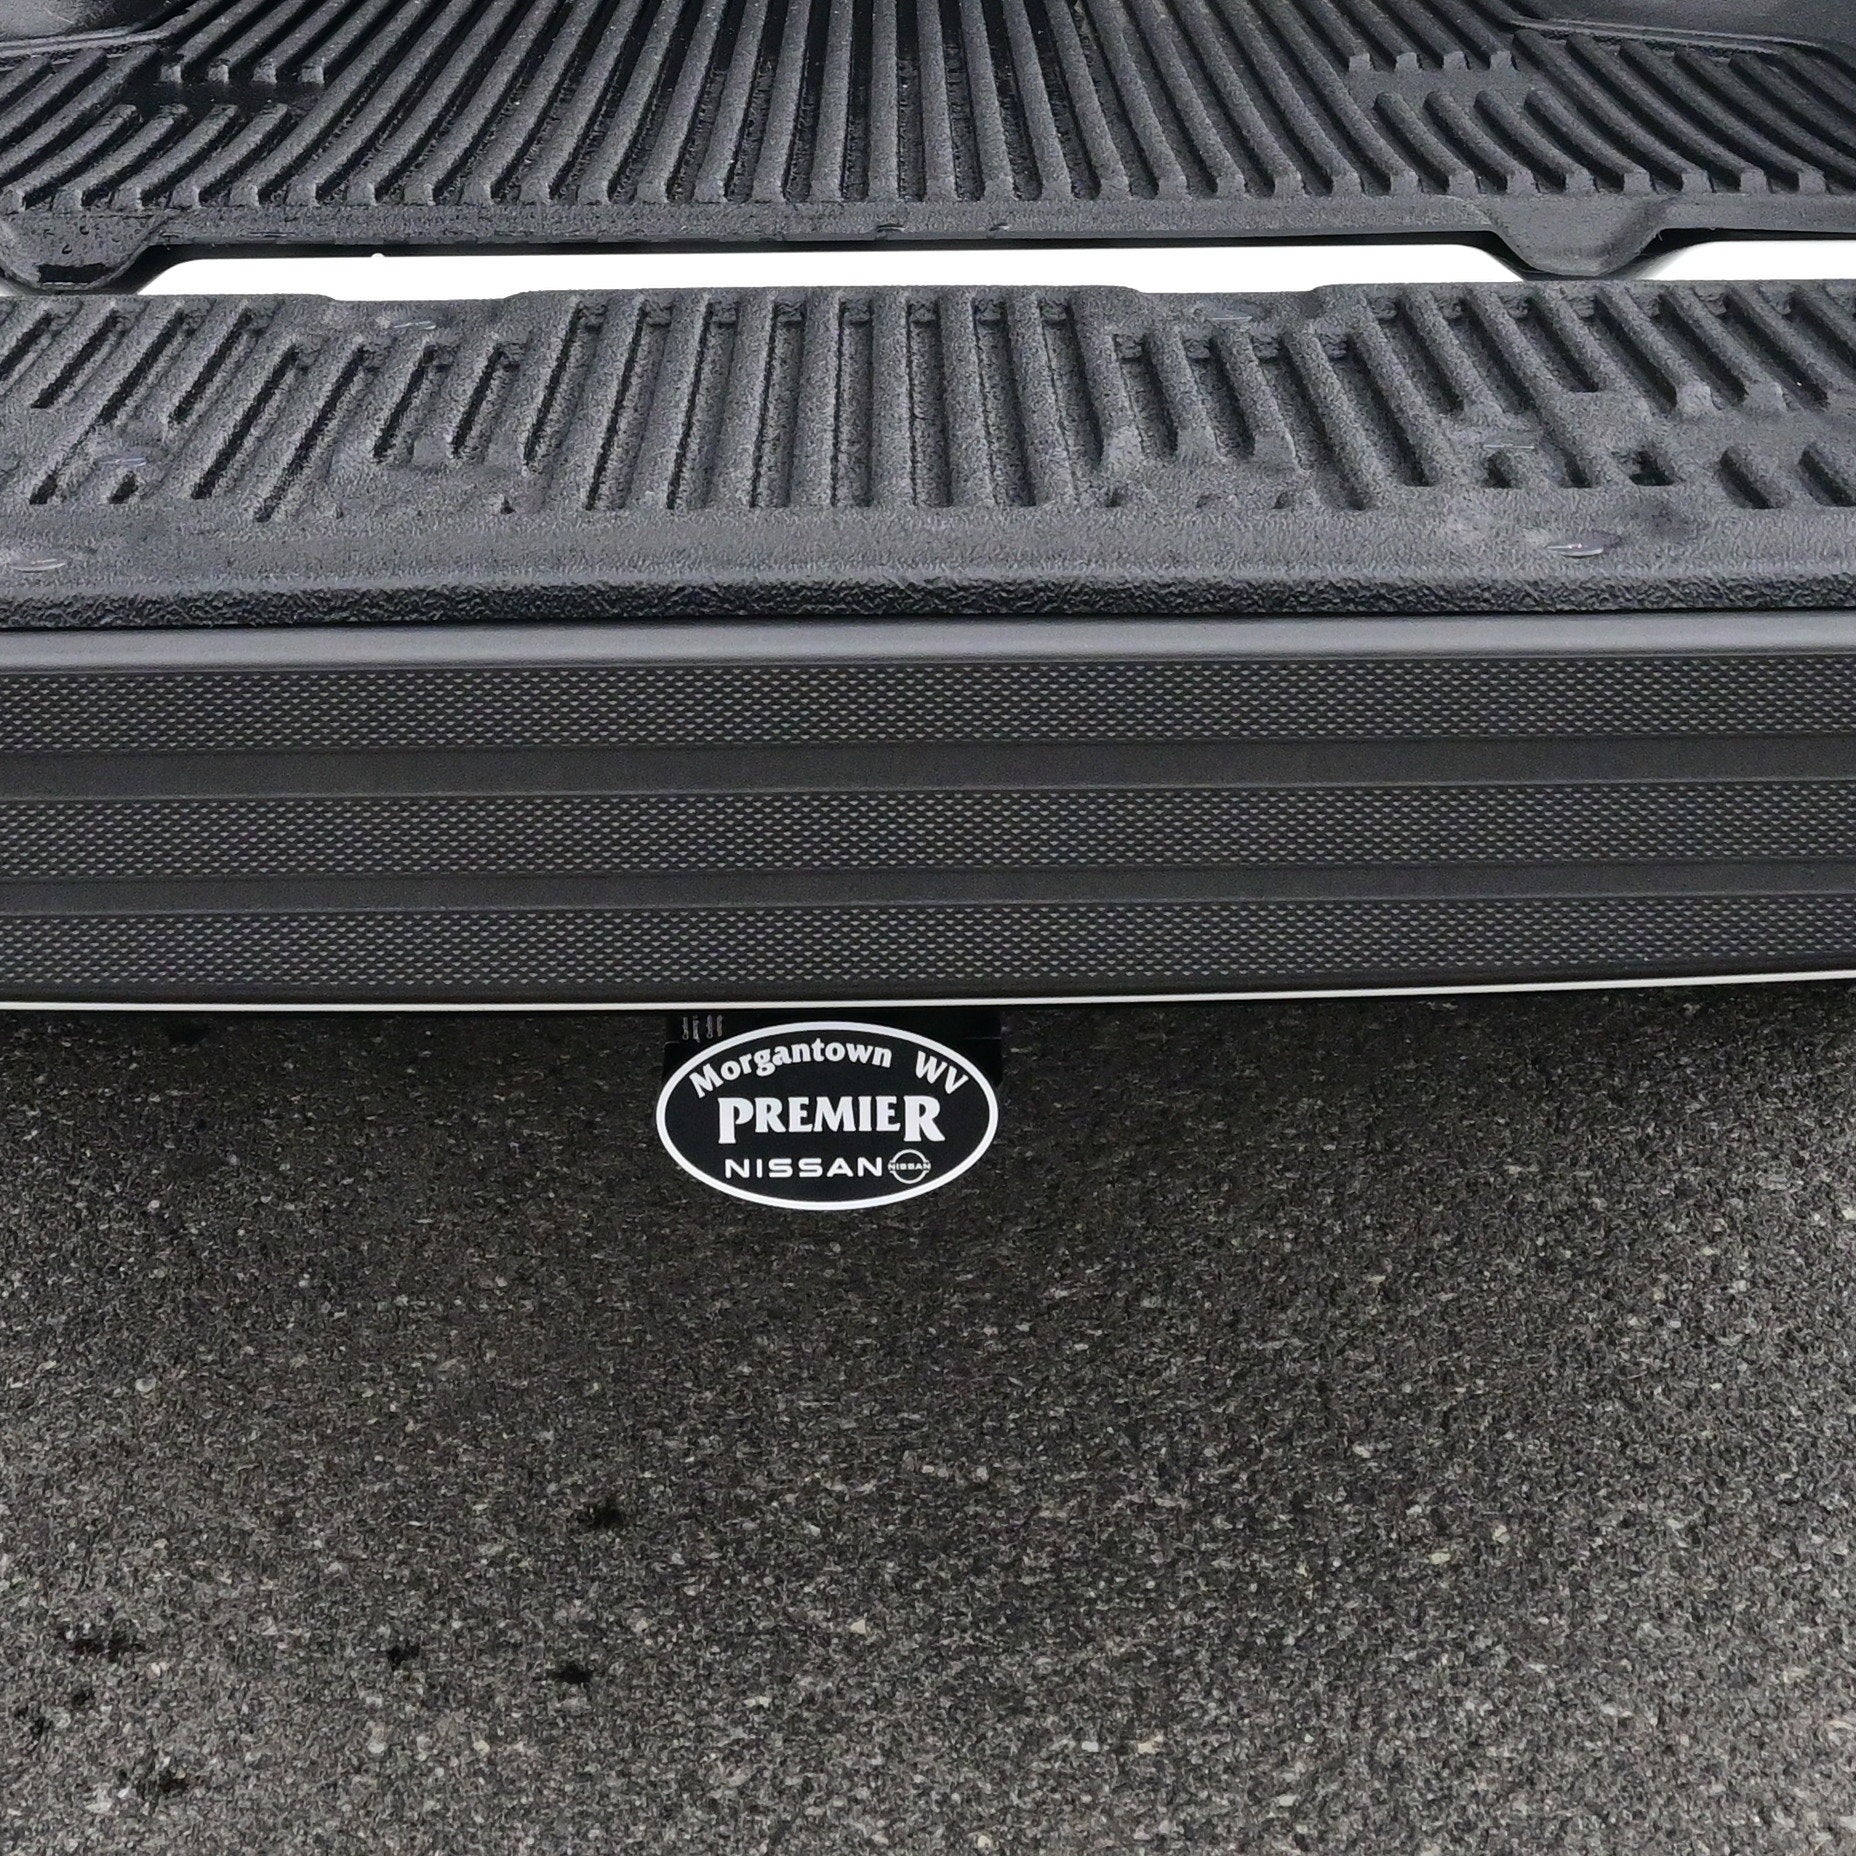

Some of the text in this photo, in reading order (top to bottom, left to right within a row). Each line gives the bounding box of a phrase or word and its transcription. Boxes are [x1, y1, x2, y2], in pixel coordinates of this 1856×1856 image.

[689, 1037, 969, 1098] Morgantown WV
[717, 1095, 945, 1144] PREMIER
[724, 1156, 932, 1179] NISSAN NISSAN
